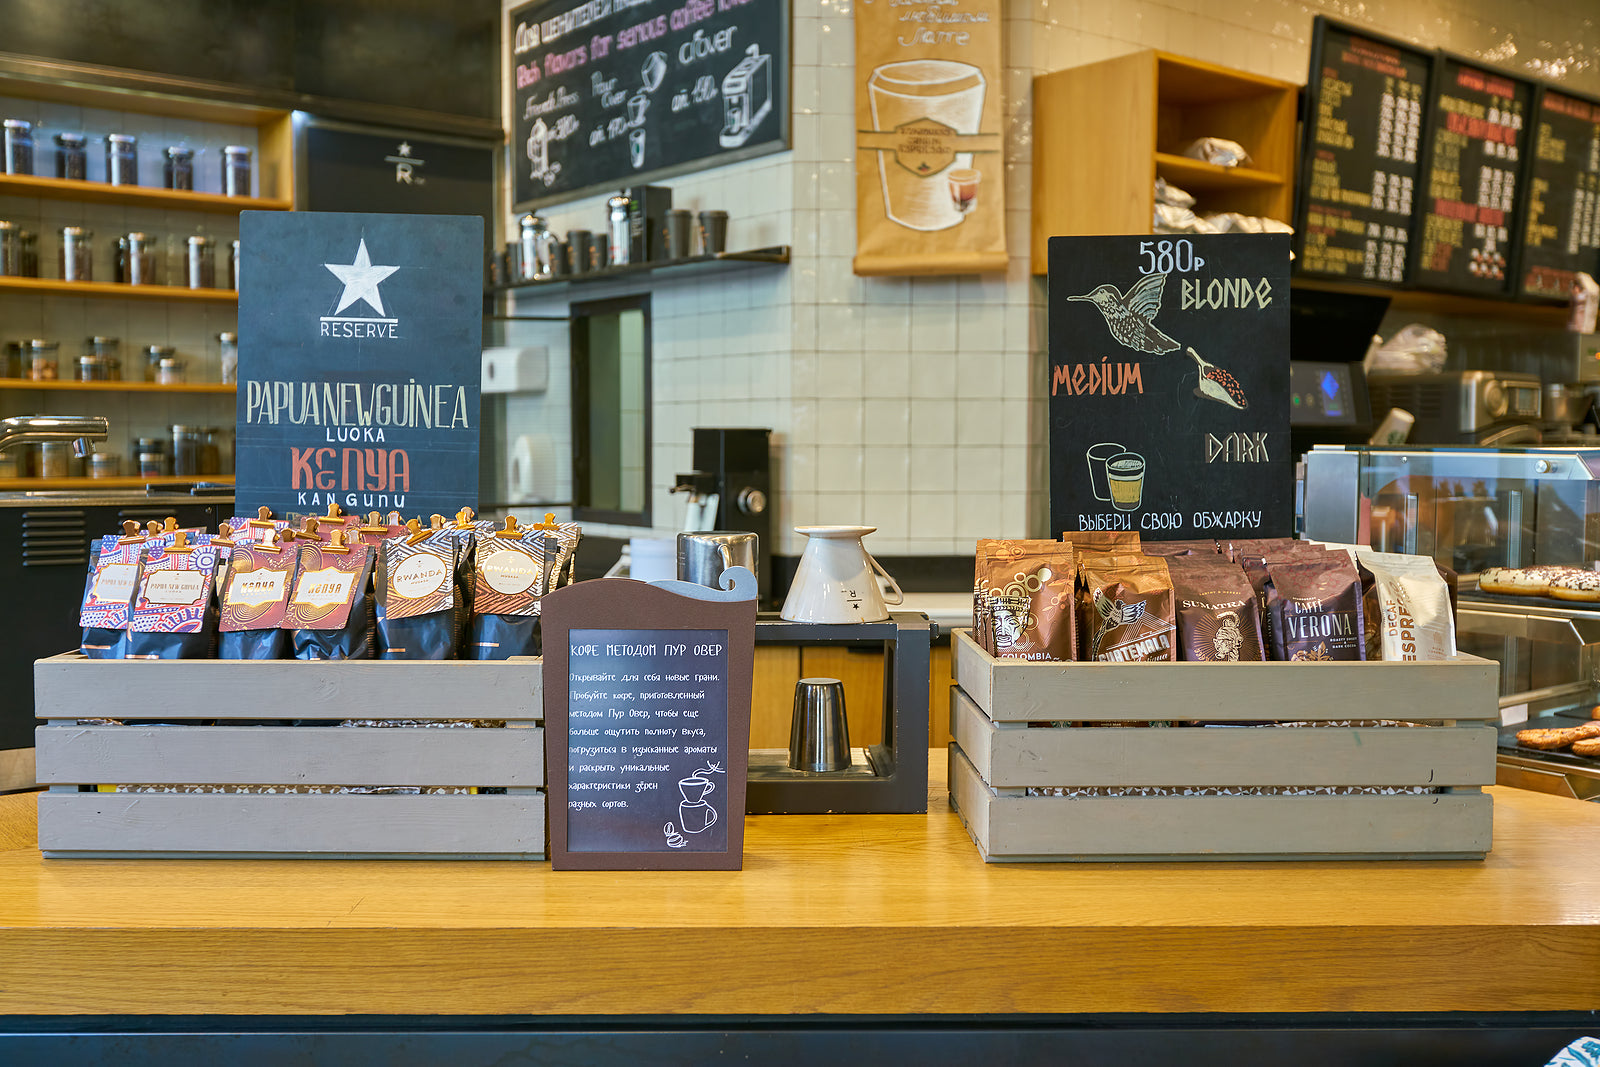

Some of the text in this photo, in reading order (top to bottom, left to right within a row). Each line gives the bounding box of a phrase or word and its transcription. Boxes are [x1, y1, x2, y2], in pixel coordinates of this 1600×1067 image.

[590, 34, 614, 60] for
[616, 15, 668, 50] serious
[396, 162, 413, 185] R
[319, 321, 399, 339] RESERVE
[326, 427, 386, 443] LUOKA
[1078, 510, 1262, 531] ВЫБЕРИ СВОЮ ОБЖАРКУ
[395, 568, 444, 583] RWANDA
[486, 564, 534, 576] RWANDA
[1182, 600, 1247, 611] SUMATRA
[1386, 599, 1399, 637] DECAF
[1288, 613, 1353, 639] VERONA
[570, 643, 723, 658] КОФЕ МЕТОДОМ ПУР ОВЕР
[1001, 652, 1052, 661] COLOMBIA
[569, 672, 720, 683] Открывайте для себя новые грани.
[569, 689, 705, 702] Пробуйте кофе, приготовленный
[569, 708, 700, 720] методом Пур Овер, чтобы еще
[569, 727, 707, 738] больше ощутить полноту вкуса,
[569, 745, 718, 757] погрузиться в изысканные ароматы
[568, 763, 671, 775] и раскрыть уникальные
[568, 781, 631, 792] характеристики
[568, 800, 629, 812] разных сортов.
